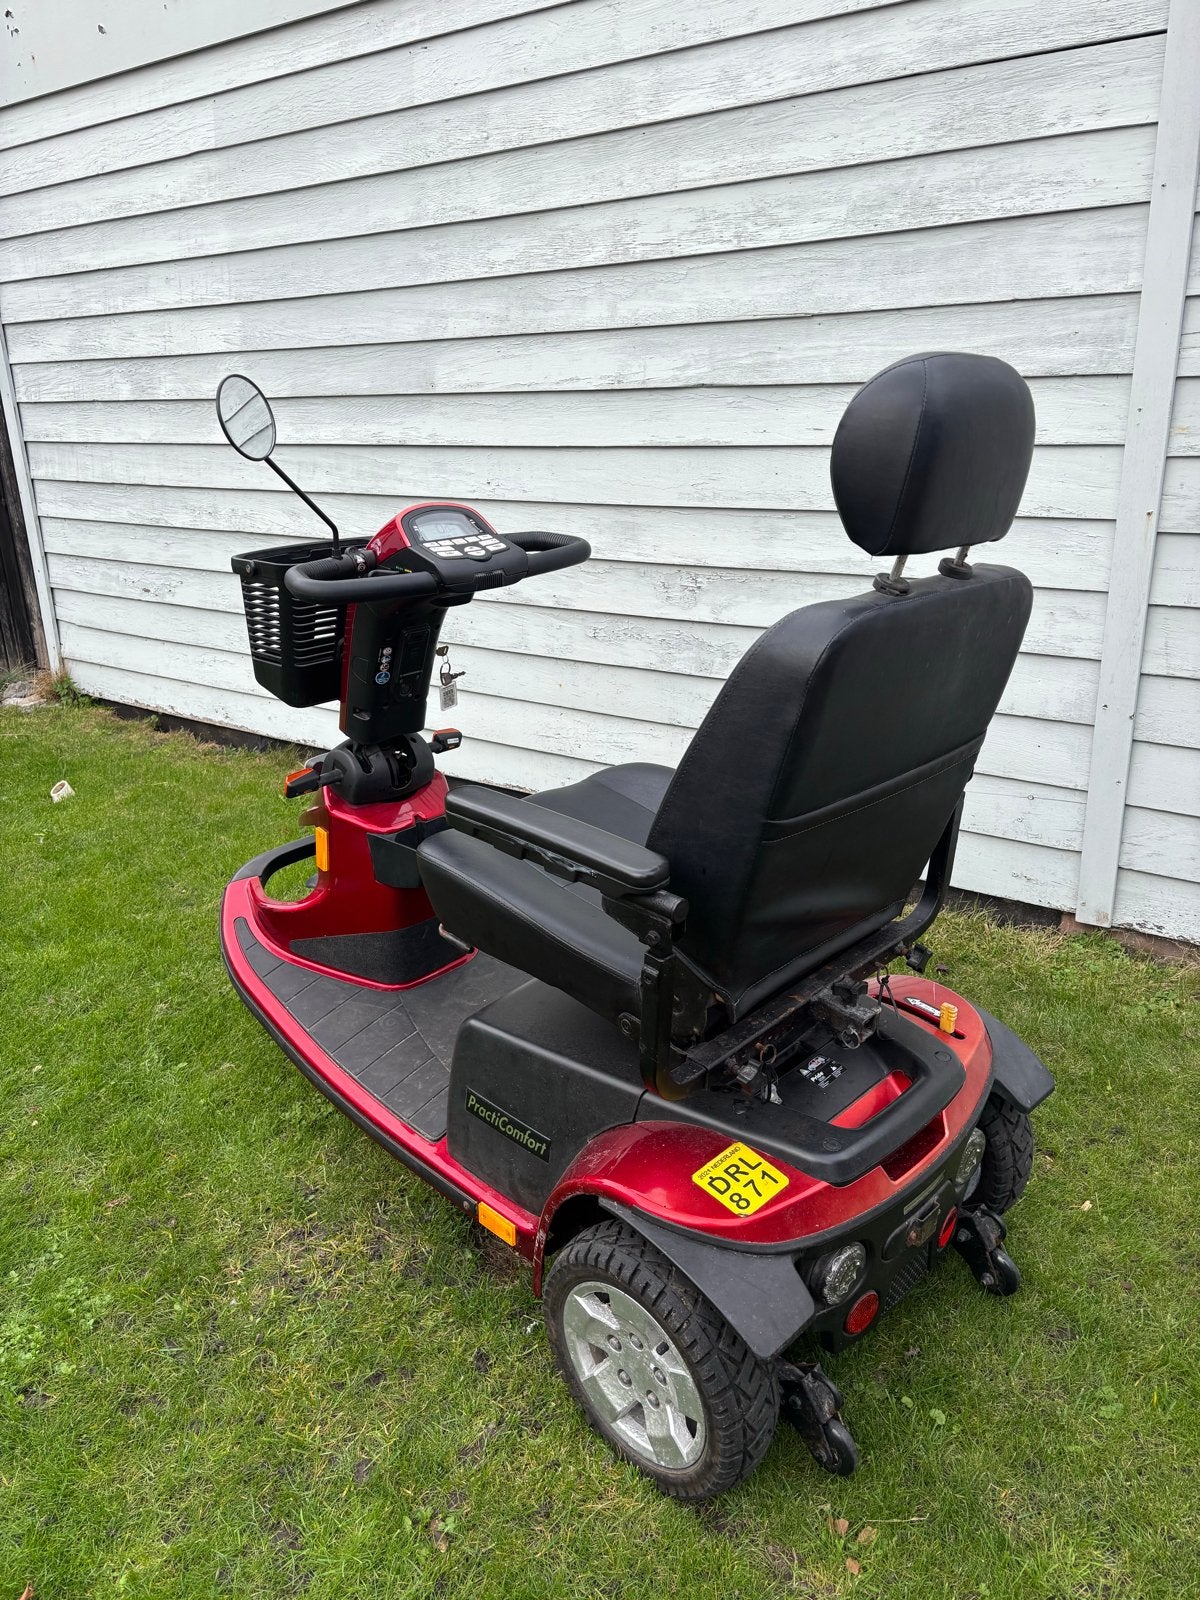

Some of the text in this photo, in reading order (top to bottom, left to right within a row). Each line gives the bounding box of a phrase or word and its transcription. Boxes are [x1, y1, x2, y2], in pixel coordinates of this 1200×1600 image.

[467, 1094, 547, 1155] PractiComfort
[697, 1146, 741, 1180] 2021 NEDERLAND
[707, 1157, 762, 1195] DRL
[729, 1170, 779, 1210] 871
